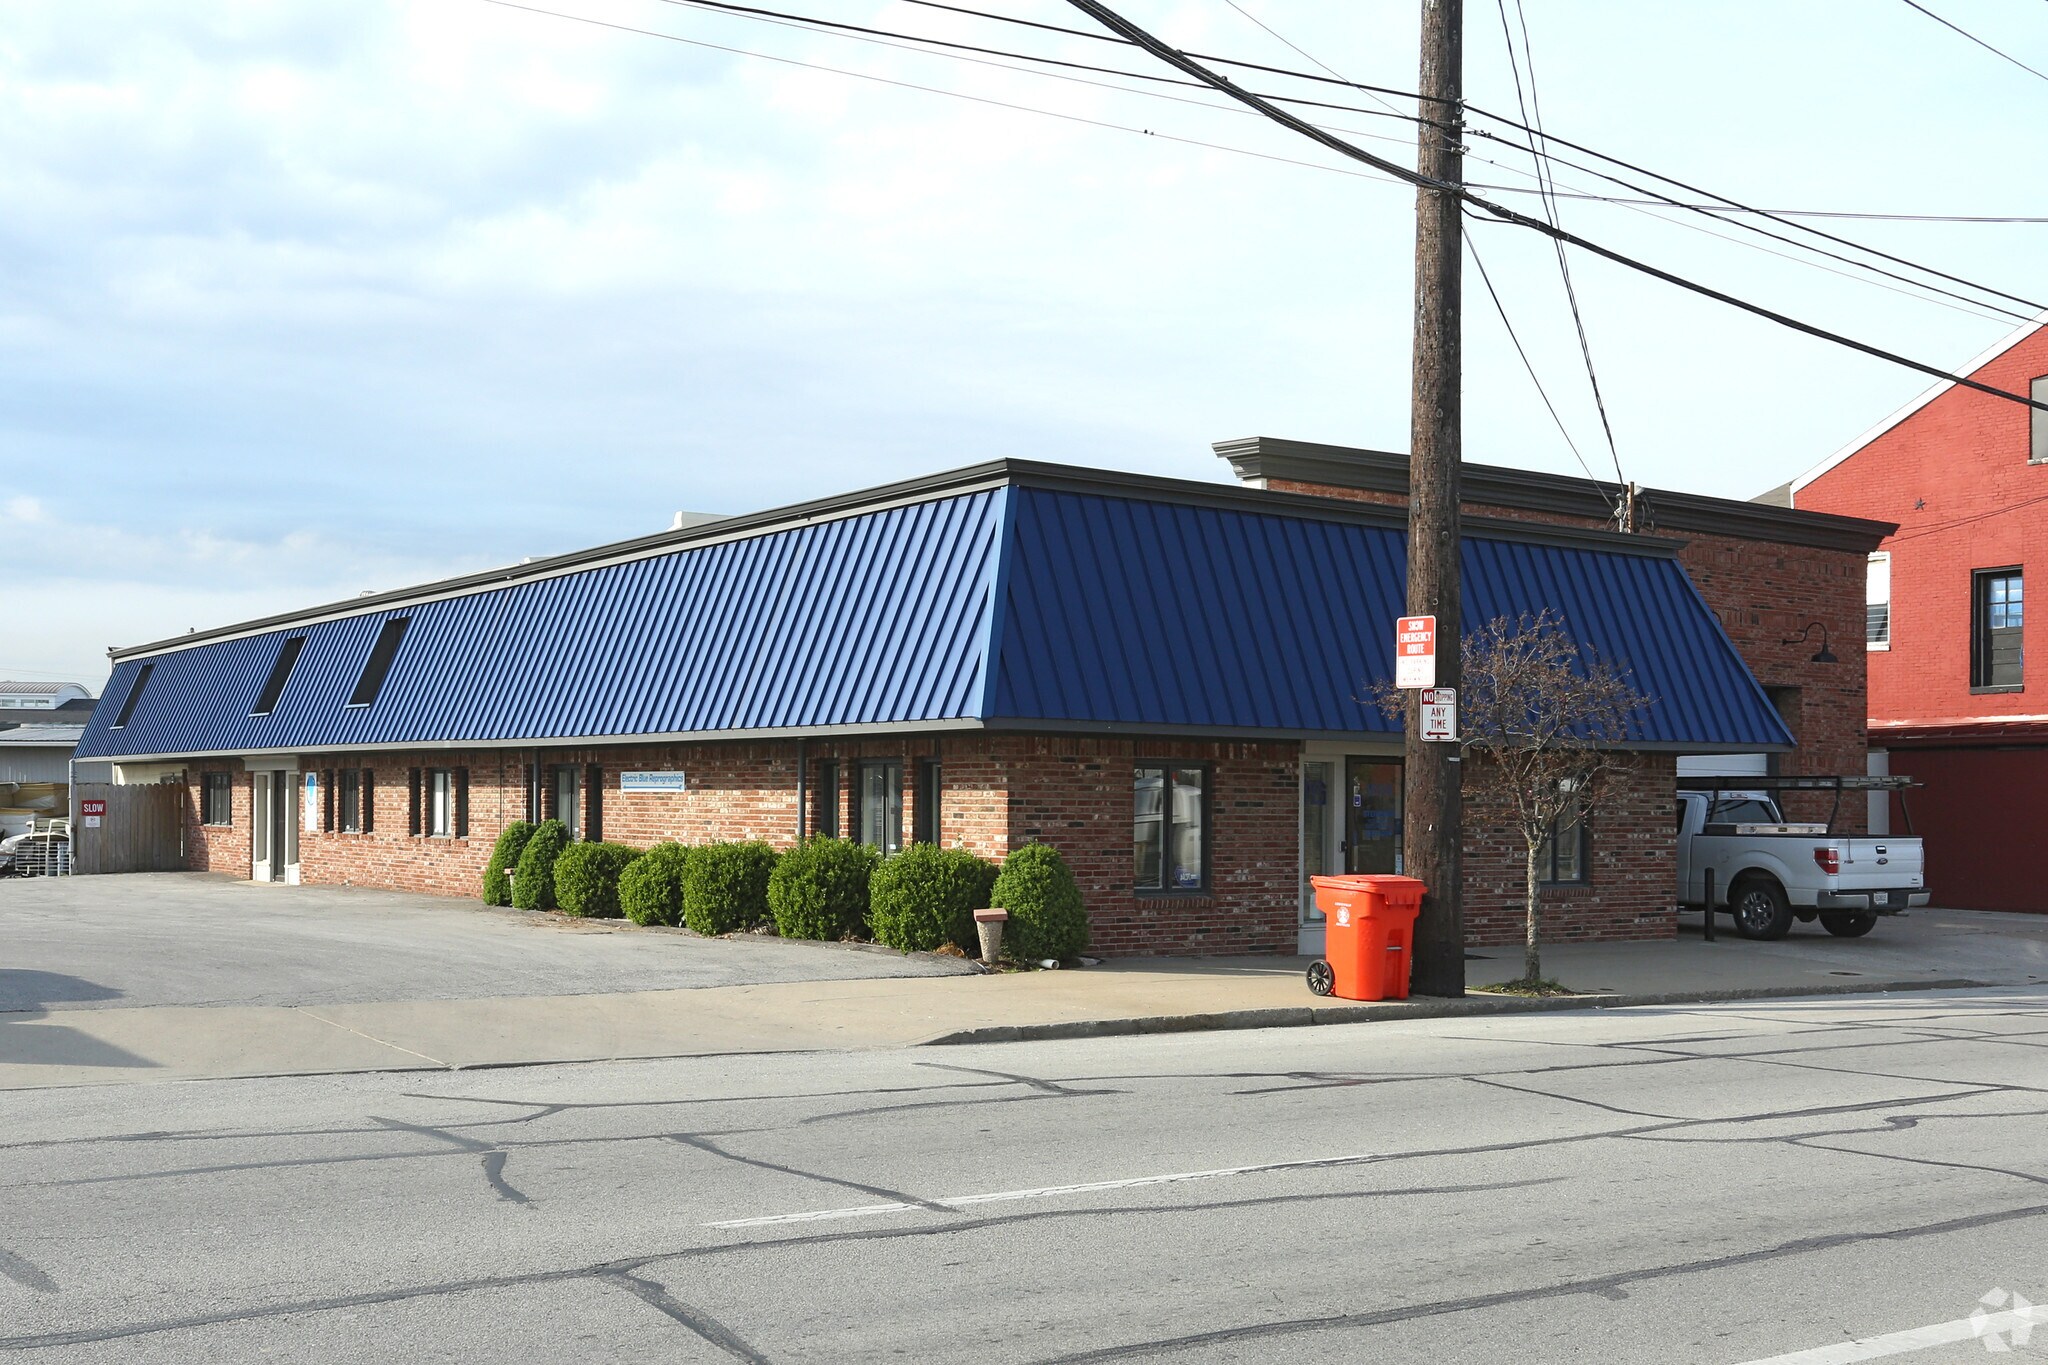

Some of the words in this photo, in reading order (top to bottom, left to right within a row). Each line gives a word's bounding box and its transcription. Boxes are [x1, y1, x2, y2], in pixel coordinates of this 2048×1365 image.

[1408, 620, 1424, 631] SNOW
[1400, 632, 1432, 643] EMERGENCY
[1407, 643, 1425, 654] ROUTE
[1423, 691, 1434, 702] NO
[1431, 707, 1446, 717] ANY
[1431, 719, 1447, 729] TIME
[622, 774, 638, 782] Electric
[639, 774, 649, 782] Blue
[650, 773, 684, 784] Reprographics
[83, 803, 104, 812] SLOW
